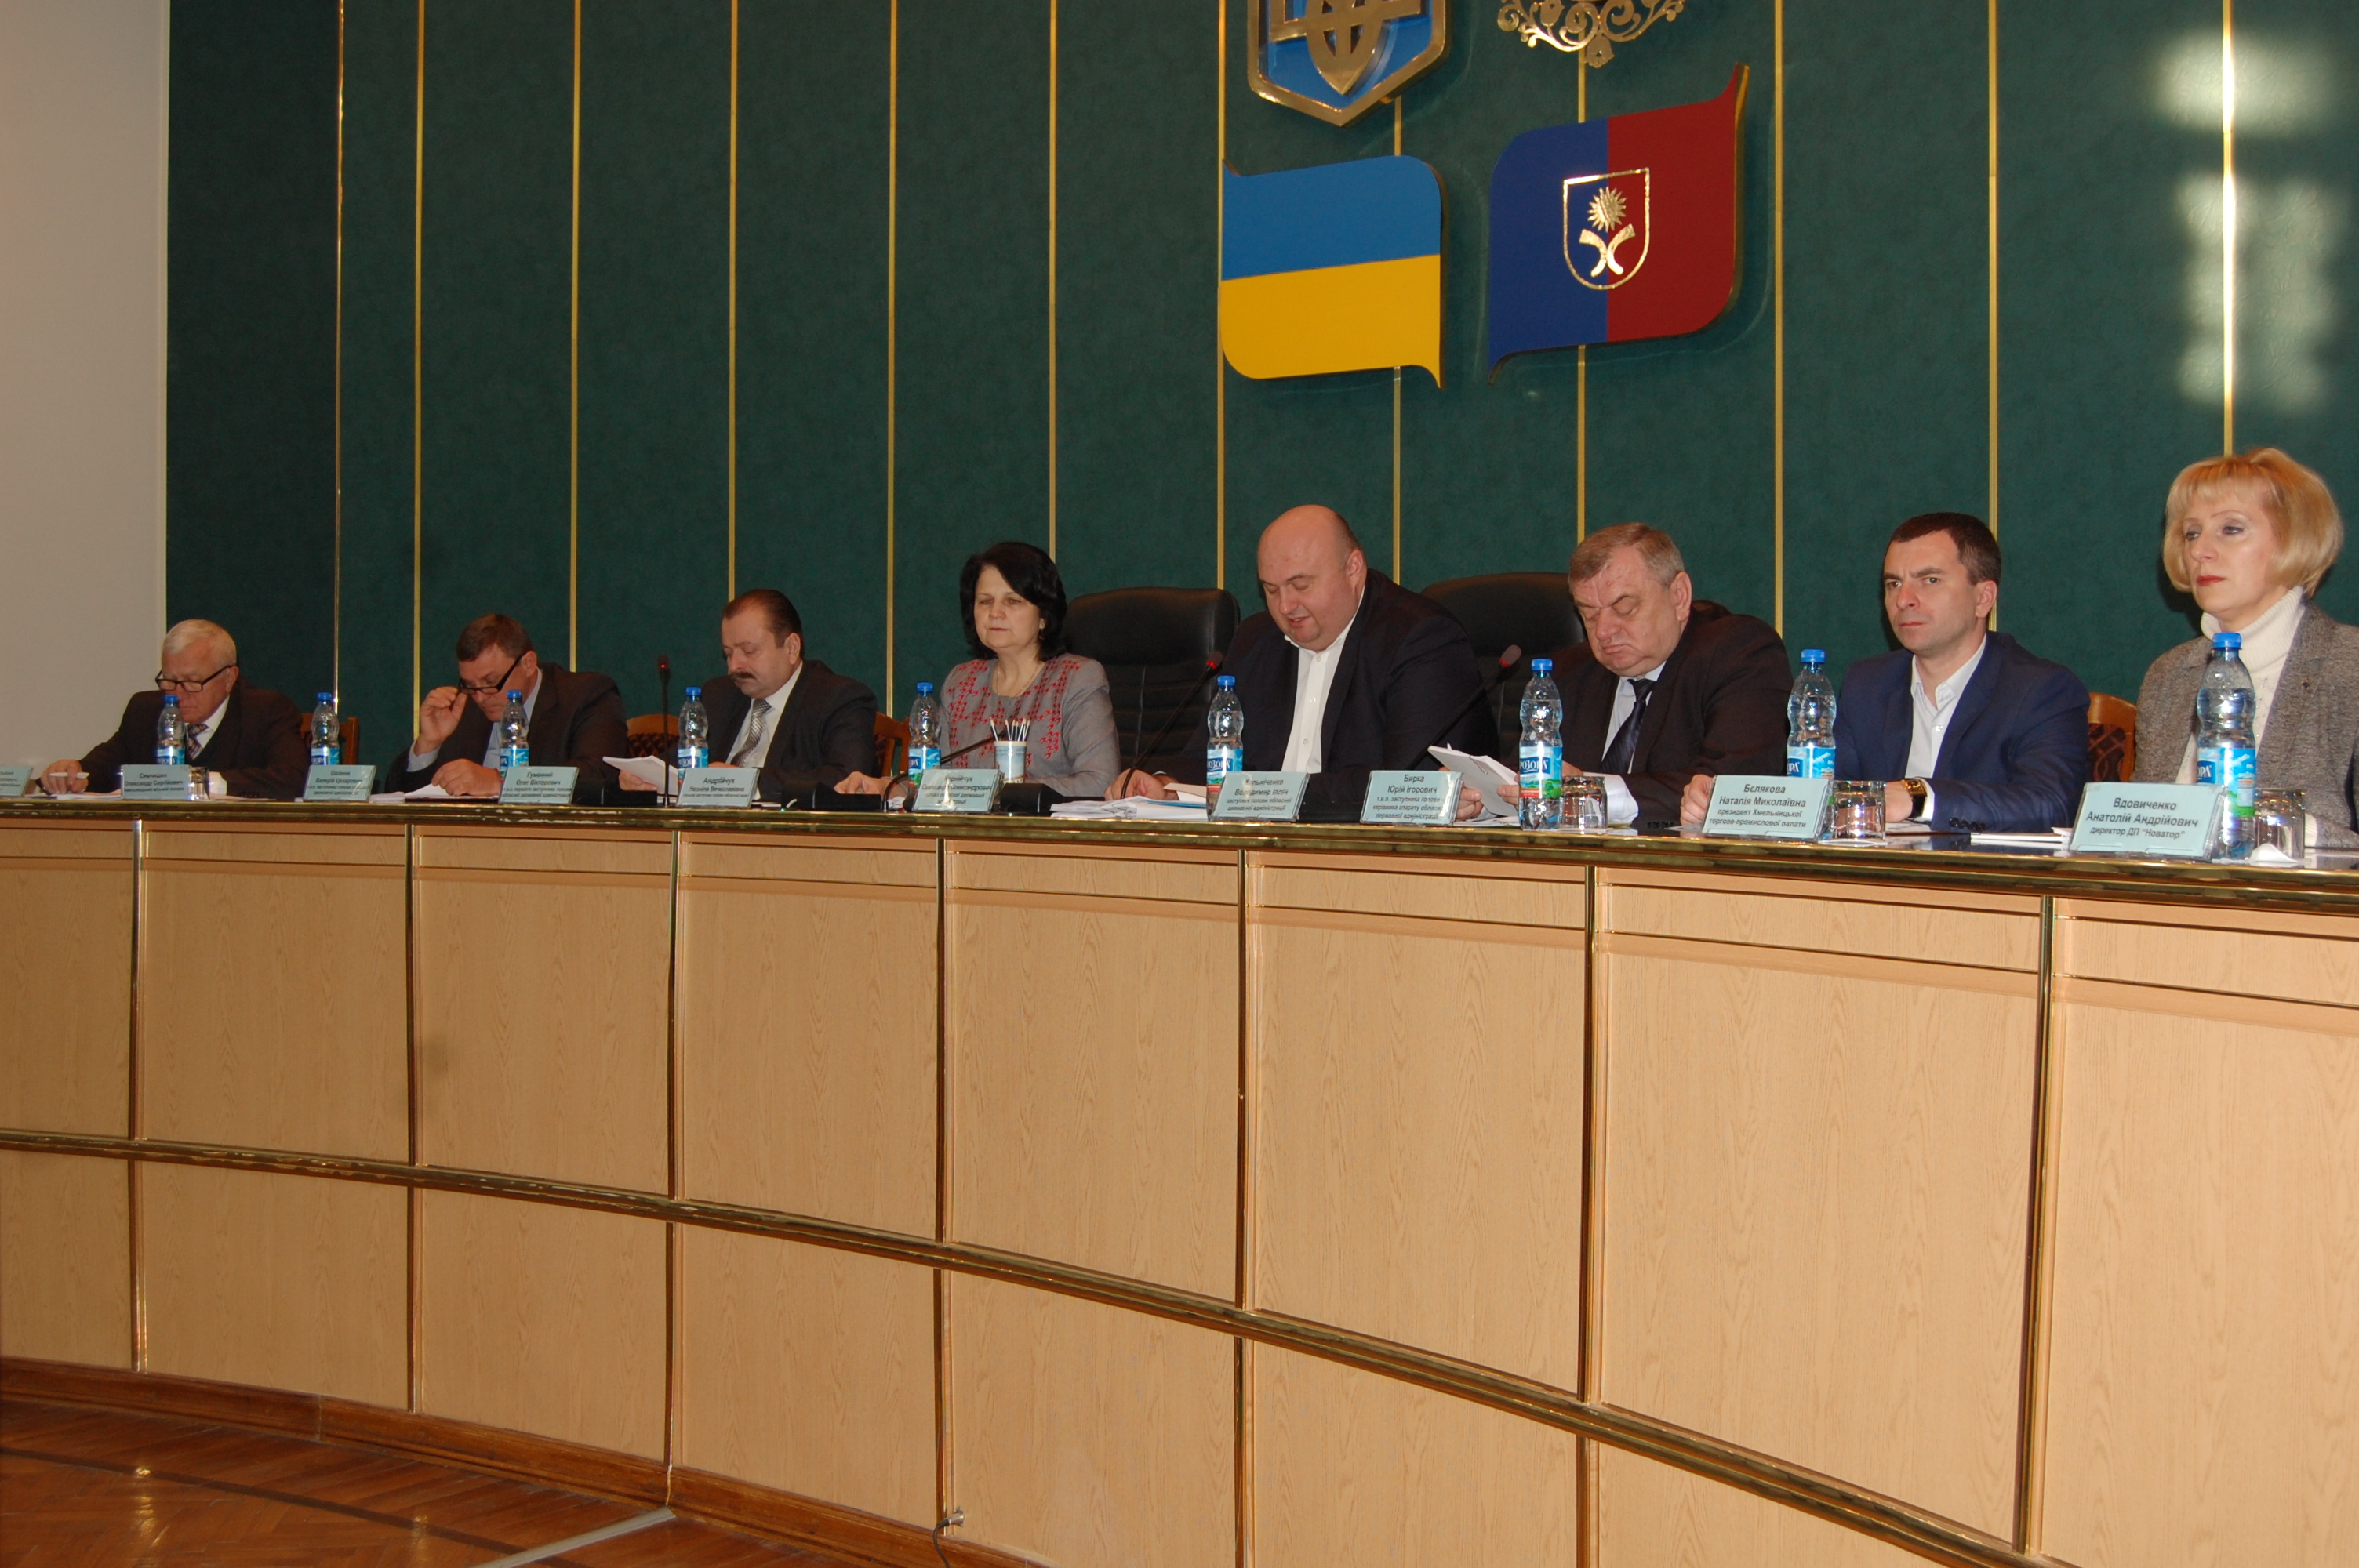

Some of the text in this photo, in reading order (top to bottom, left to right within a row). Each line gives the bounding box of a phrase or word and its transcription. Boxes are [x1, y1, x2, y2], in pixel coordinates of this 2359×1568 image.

[1387, 785, 1405, 794] Юрій
[1743, 784, 1786, 793] Бєлякова
[1719, 797, 1806, 807] Наталія Миколаївна
[2113, 798, 2177, 811] Вдовиченко
[1753, 809, 1803, 818] Хмельницької
[2085, 811, 2199, 827] Анатолій Андрійович
[2089, 827, 2126, 836] директор
[2126, 828, 2140, 837] ДП
